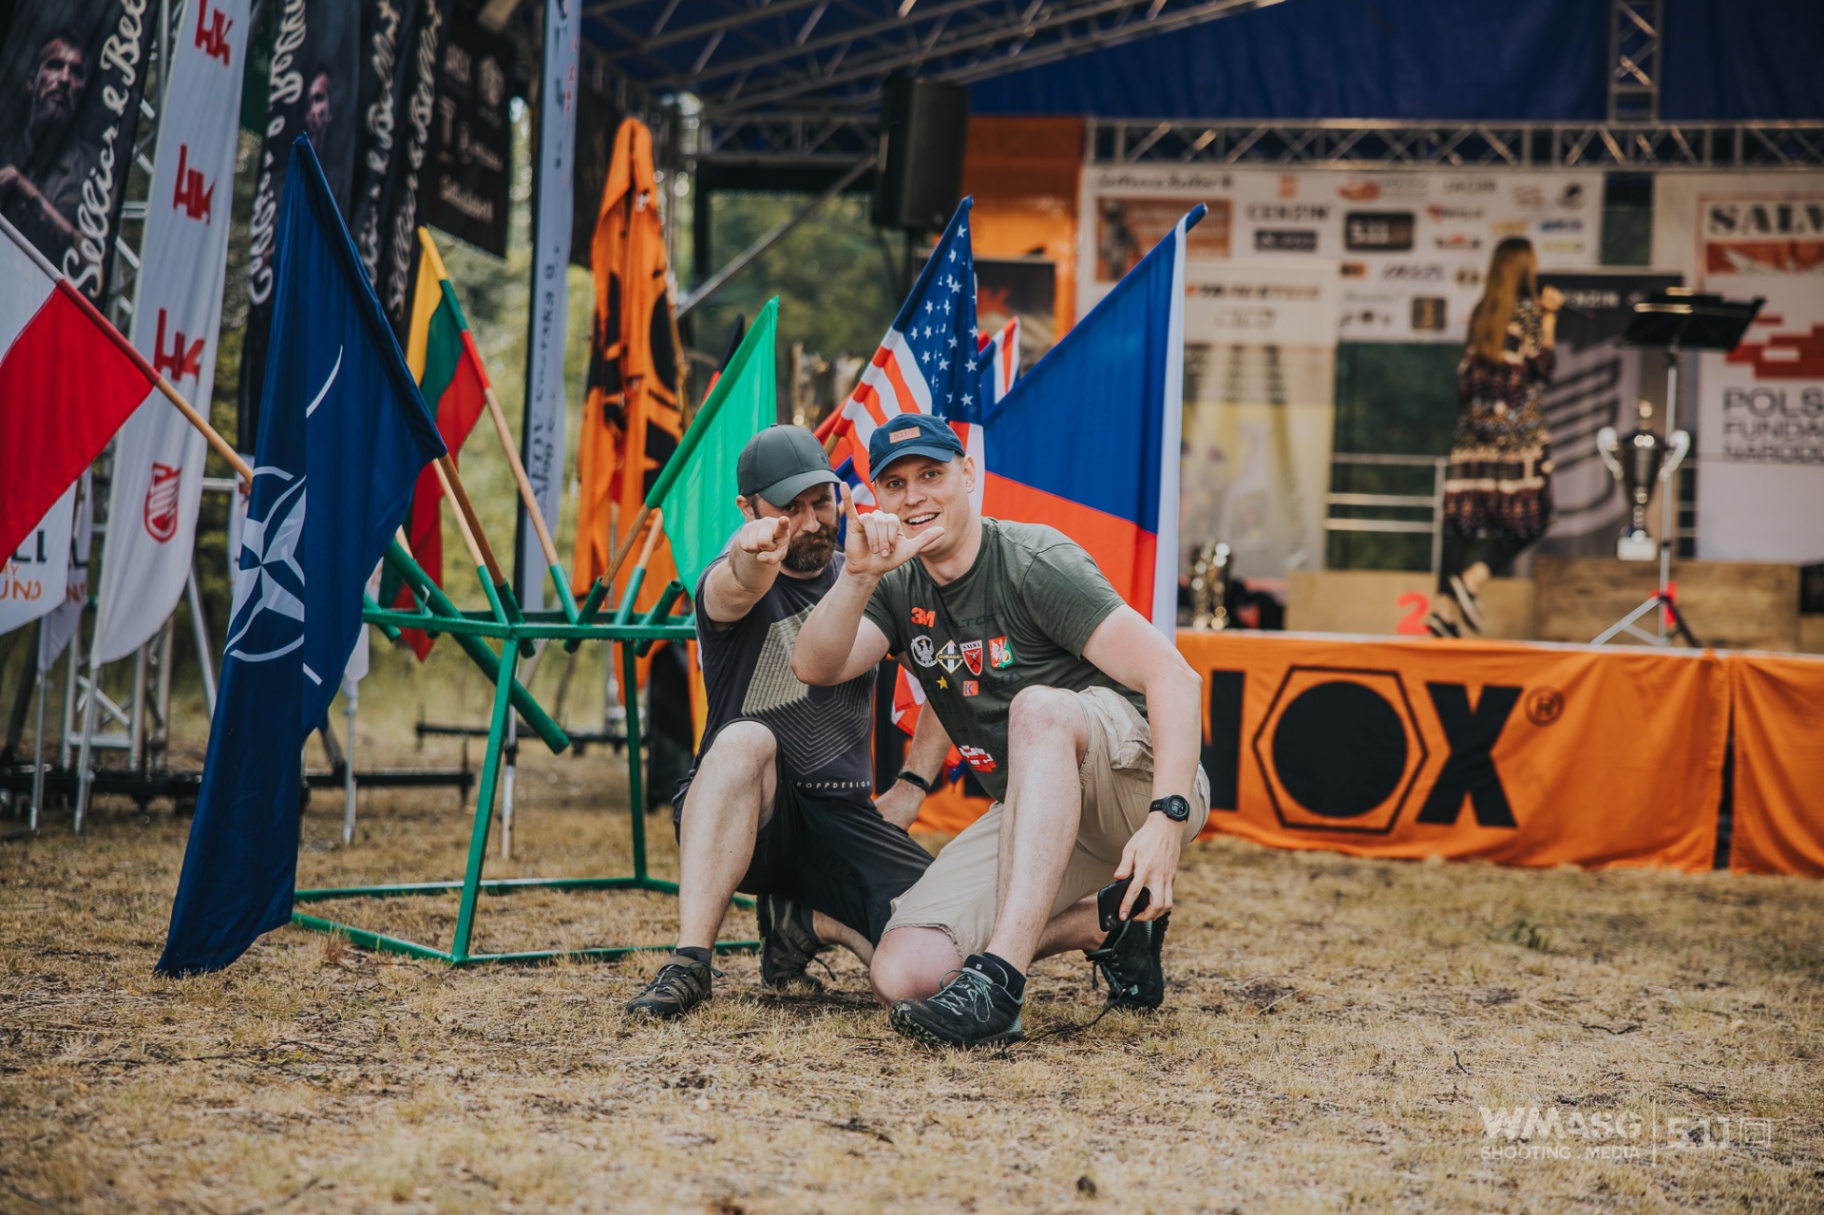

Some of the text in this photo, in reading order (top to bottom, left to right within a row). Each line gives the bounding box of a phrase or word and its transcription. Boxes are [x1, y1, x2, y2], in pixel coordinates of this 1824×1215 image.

[173, 143, 217, 227] HK
[911, 607, 936, 628] 3M
[1395, 591, 1430, 635] 2
